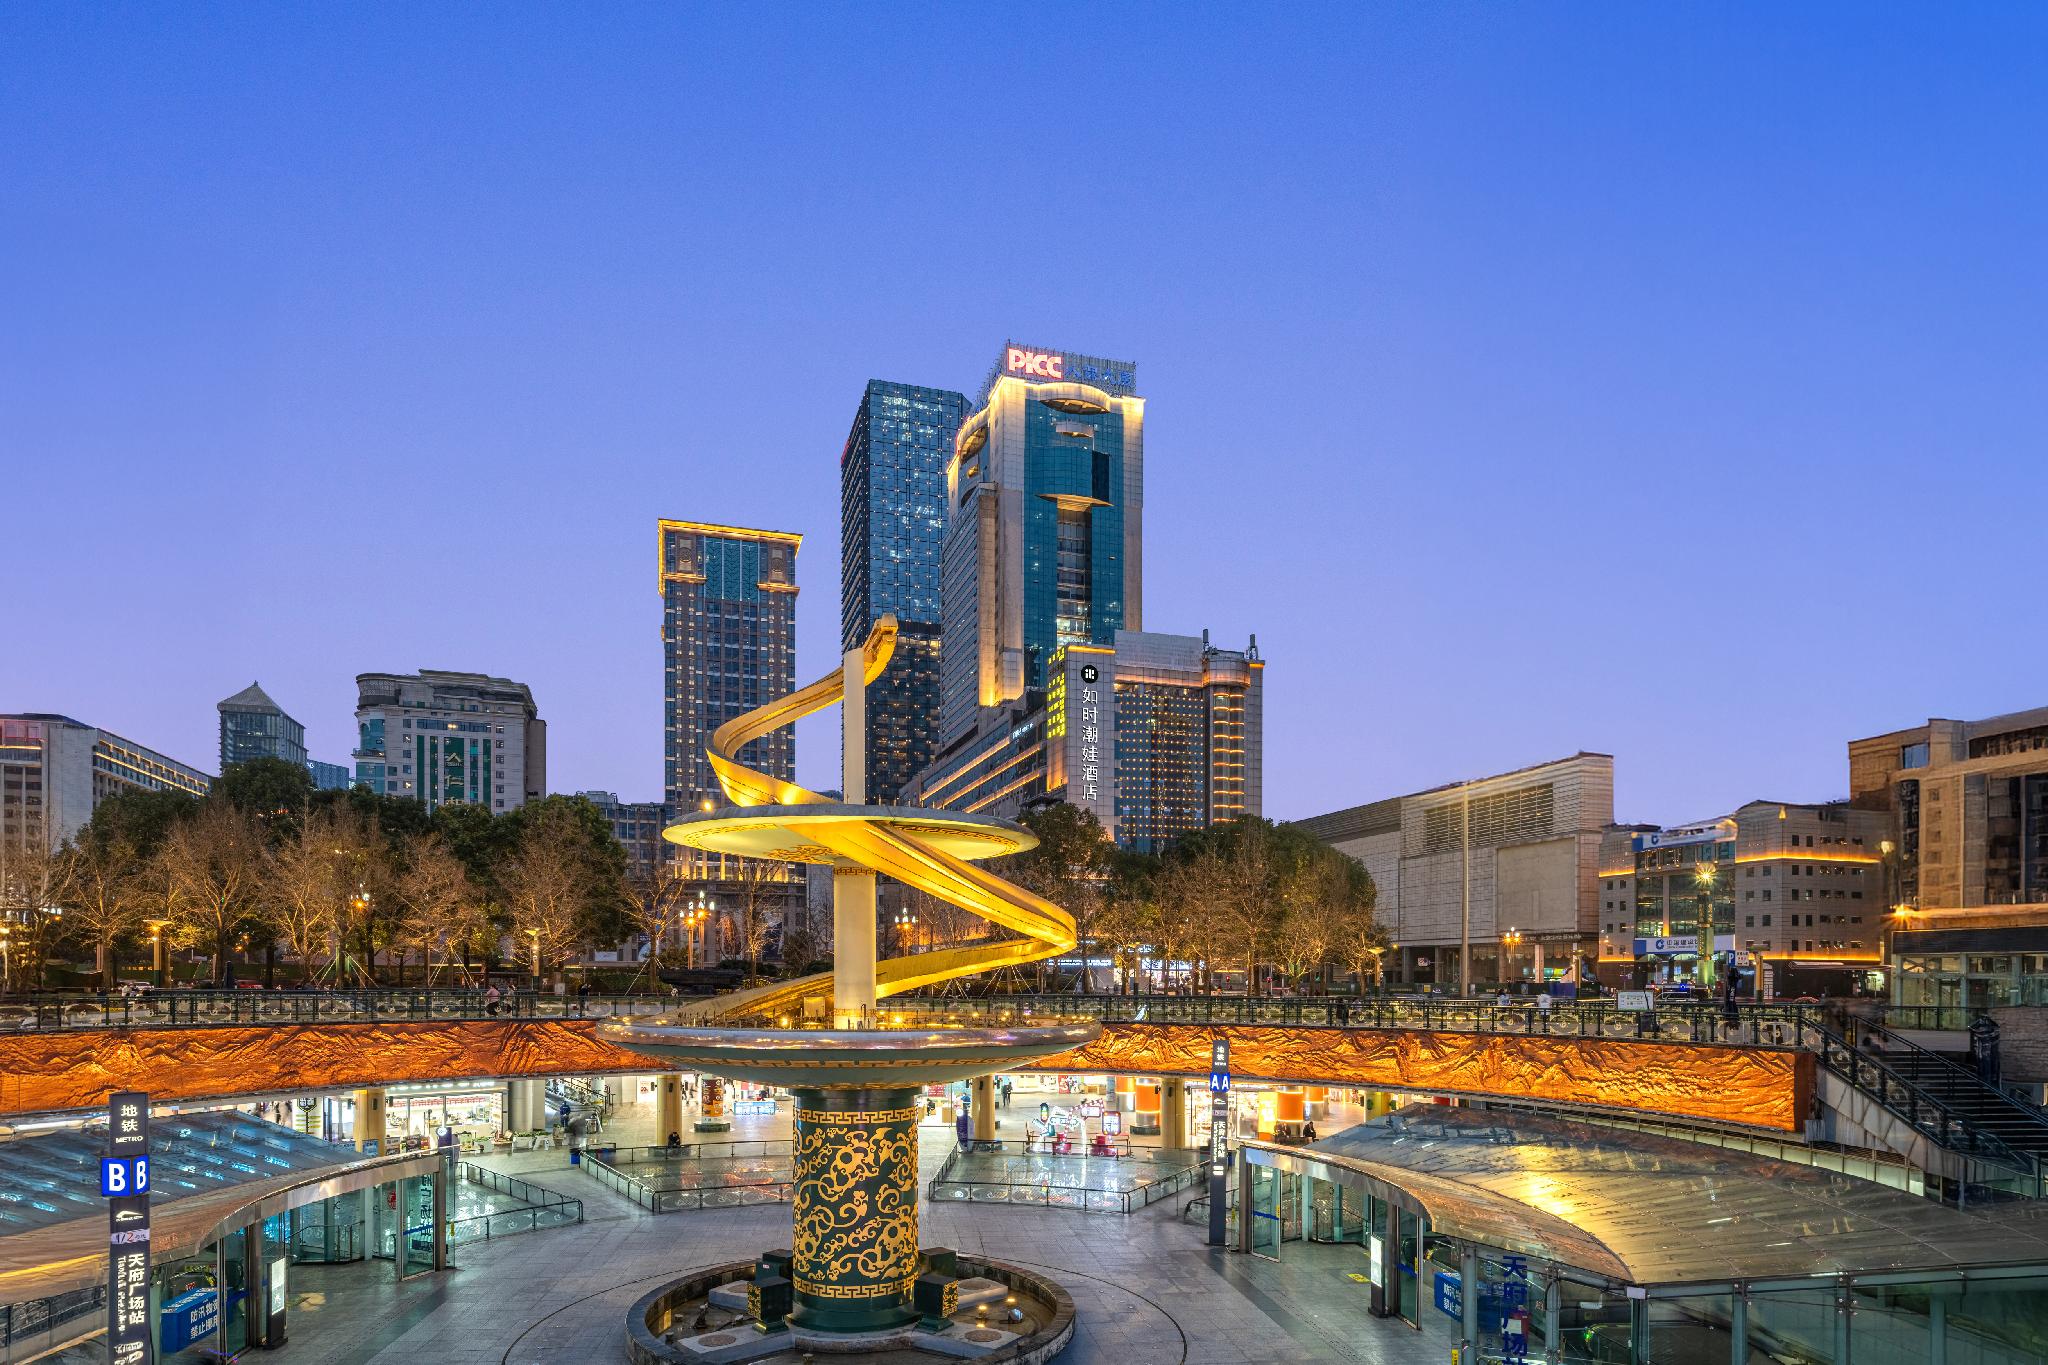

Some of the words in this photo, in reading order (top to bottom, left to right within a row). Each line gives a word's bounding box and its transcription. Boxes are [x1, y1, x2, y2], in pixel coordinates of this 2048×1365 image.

[1008, 348, 1062, 379] PICC
[1082, 686, 1099, 800] 如时潮娃酒店
[1728, 952, 1734, 964] P
[1217, 1046, 1224, 1060] 地铁
[1211, 1075, 1219, 1090] A
[1222, 1077, 1229, 1090] A
[120, 1104, 138, 1132] 地铁
[115, 1135, 144, 1143] METRO
[108, 1163, 126, 1191] B
[136, 1160, 147, 1189] B
[128, 1253, 146, 1325] 天府广场站
